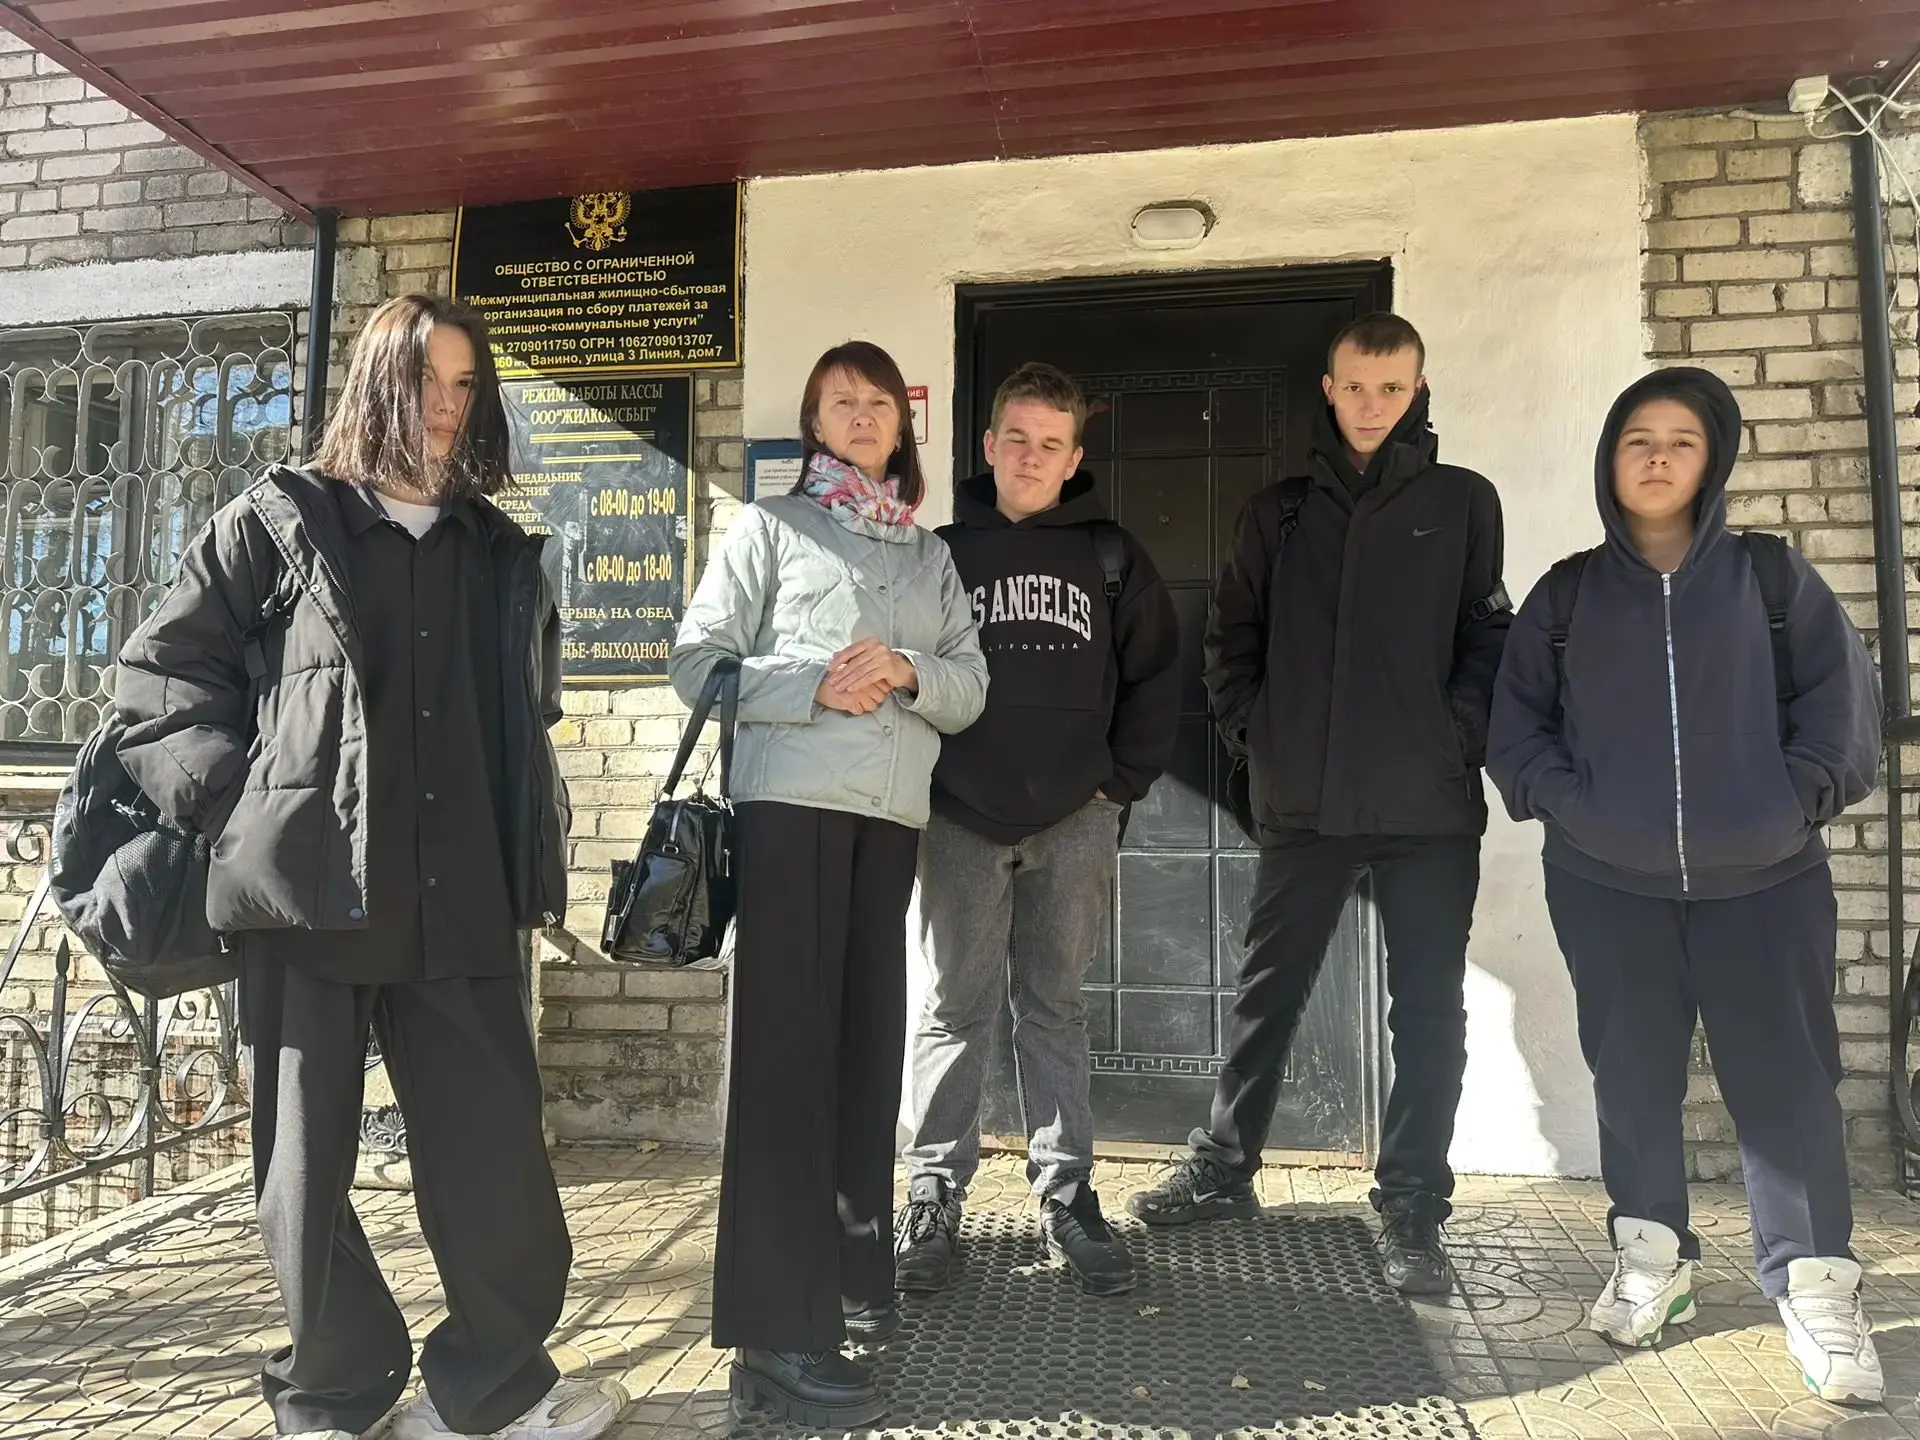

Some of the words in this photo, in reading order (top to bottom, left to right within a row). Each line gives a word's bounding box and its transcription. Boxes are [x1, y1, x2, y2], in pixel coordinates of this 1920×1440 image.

[495, 261, 569, 276] ОБЩЕСТВО
[573, 260, 583, 271] С
[586, 252, 695, 270] ОГРАНИЧЕННОЙ
[521, 270, 667, 289] ОТВЕТСТВЕННОСТЬЮ
[598, 283, 726, 300] жилищно-сбытовая
[484, 307, 563, 322] организация
[567, 307, 583, 317] по
[586, 303, 625, 319] сбору
[628, 299, 690, 314] платежей
[694, 301, 708, 311] за
[488, 318, 649, 336] жилищно-коммунальные
[506, 339, 576, 353] 2709011750
[579, 337, 615, 350] ОГРН
[618, 334, 713, 348] 1062709013707
[531, 353, 582, 367] Ванино,
[585, 352, 625, 365] улица
[628, 350, 636, 361] 3
[640, 347, 684, 362] Линия,
[521, 387, 567, 405] РЕЖИМ
[569, 385, 617, 402] РАБОТЫ
[621, 383, 663, 400] КАССЫ
[499, 500, 532, 511] СРЕДА
[591, 496, 598, 516] с
[600, 488, 628, 516] 08-00
[629, 495, 645, 520] до
[647, 487, 676, 515] 19-00
[587, 562, 594, 582] с
[596, 554, 624, 582] 08-00
[626, 561, 641, 586] до
[643, 553, 672, 581] 18-00
[611, 607, 632, 619] НА
[635, 607, 674, 620] ОБЕД
[990, 574, 1091, 641] ANGELES
[593, 638, 669, 662] ВЫХОДНОЙ
[981, 642, 1078, 652] LIFORNIA
